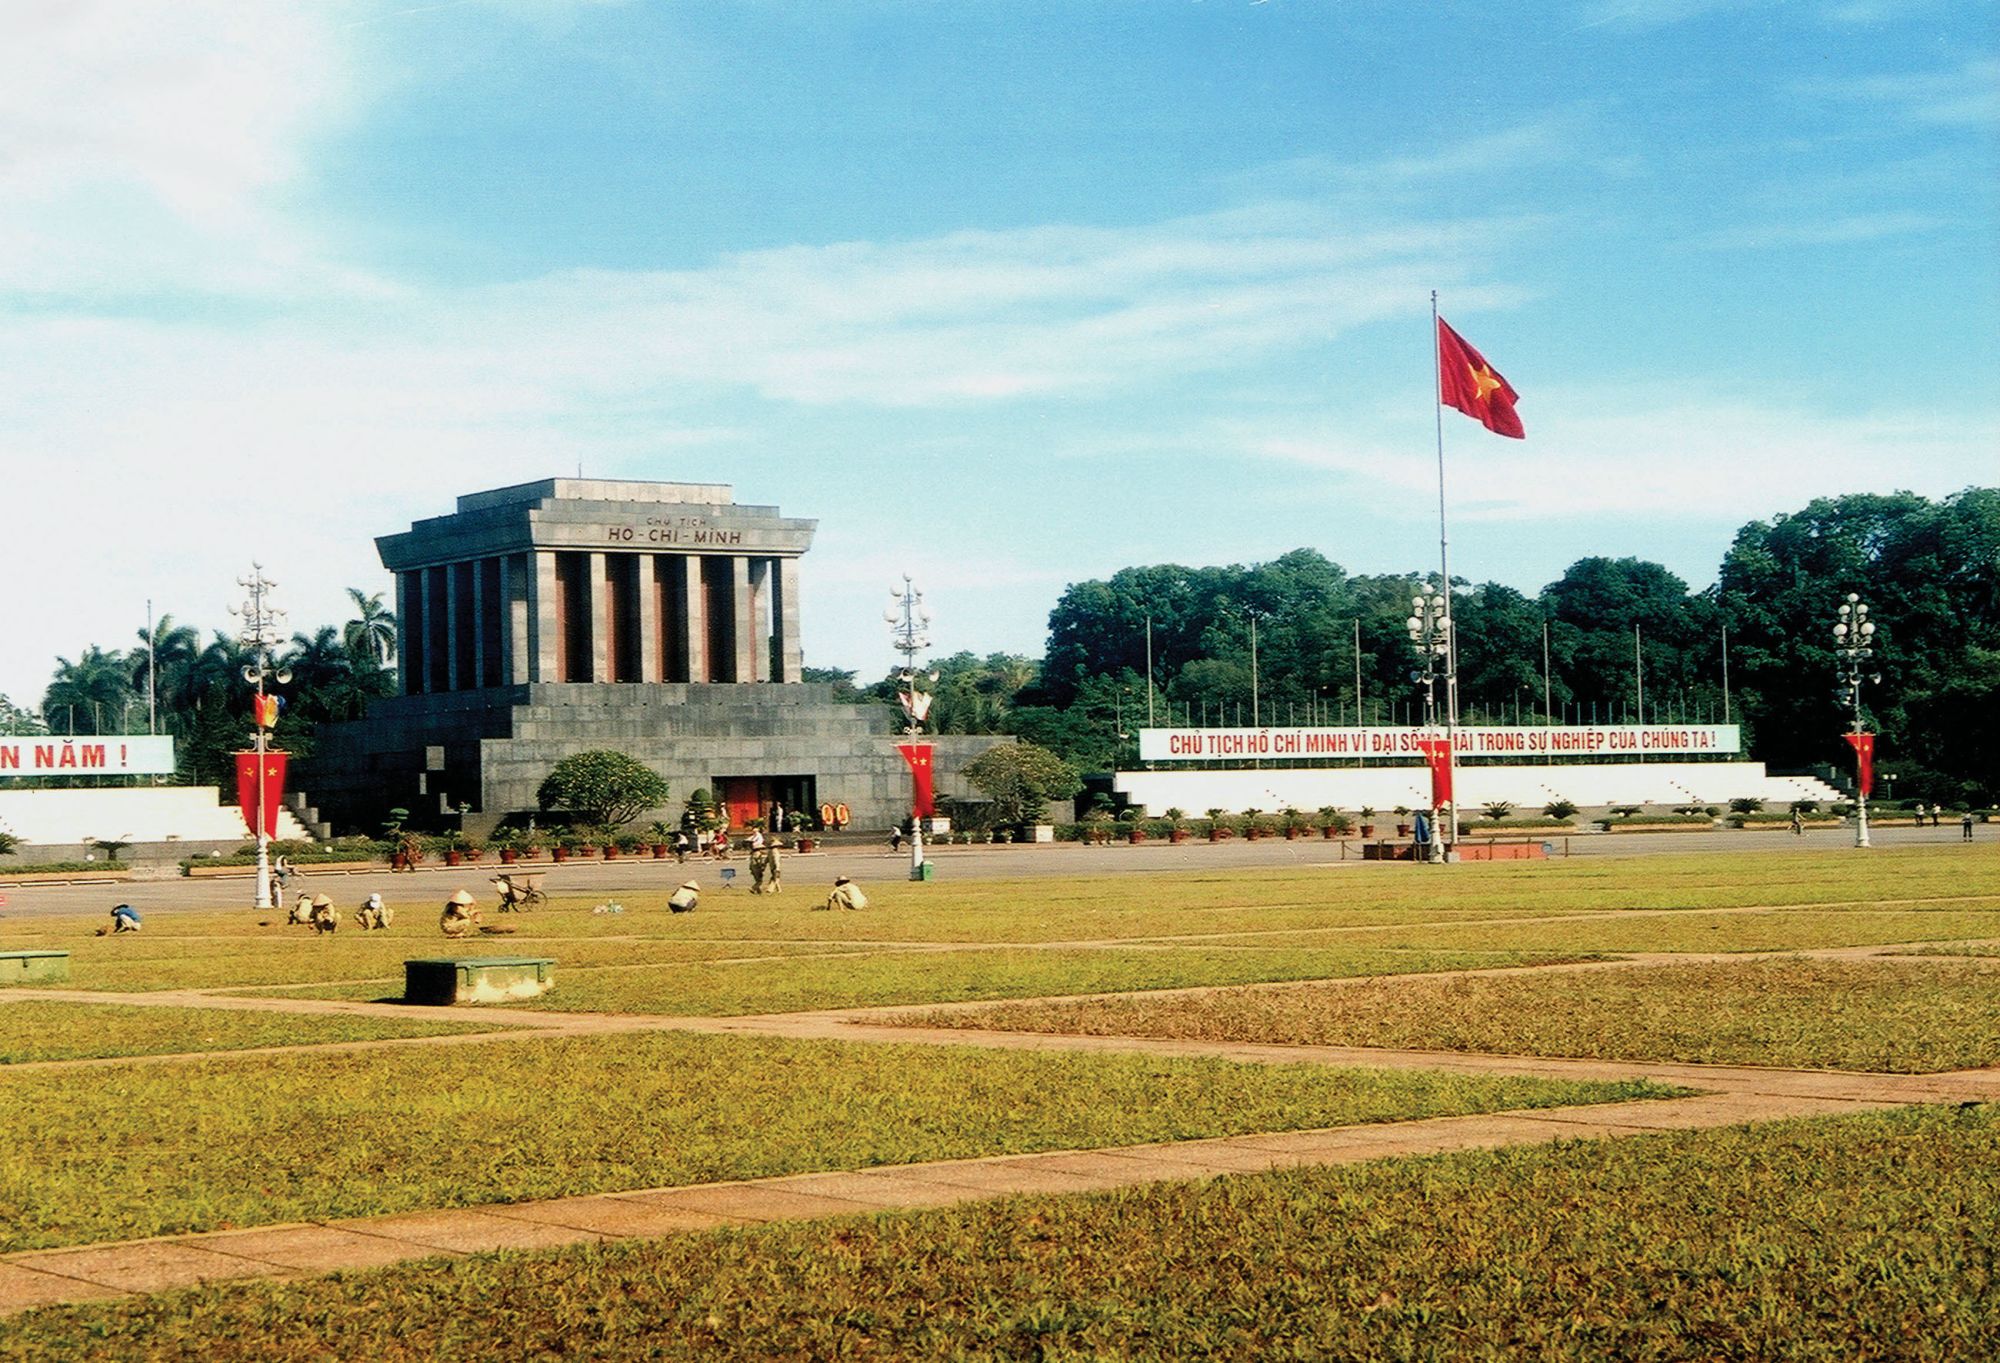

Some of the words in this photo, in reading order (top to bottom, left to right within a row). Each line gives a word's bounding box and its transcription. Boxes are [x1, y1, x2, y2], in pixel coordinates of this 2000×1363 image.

[35, 739, 105, 768] NĂM
[1170, 730, 1202, 754] CHỦ
[1207, 735, 1243, 758] TỊCH
[1247, 729, 1269, 753] HỒ
[1274, 730, 1302, 753] CHÍ
[1306, 733, 1347, 753] MINH
[1372, 733, 1397, 755] ĐẠI
[1478, 732, 1525, 751] TRONG
[1528, 730, 1548, 754] SỰ
[1552, 728, 1604, 753] NGHIỆP
[1610, 726, 1637, 749] CỦA
[1642, 727, 1688, 749] CHÚNG
